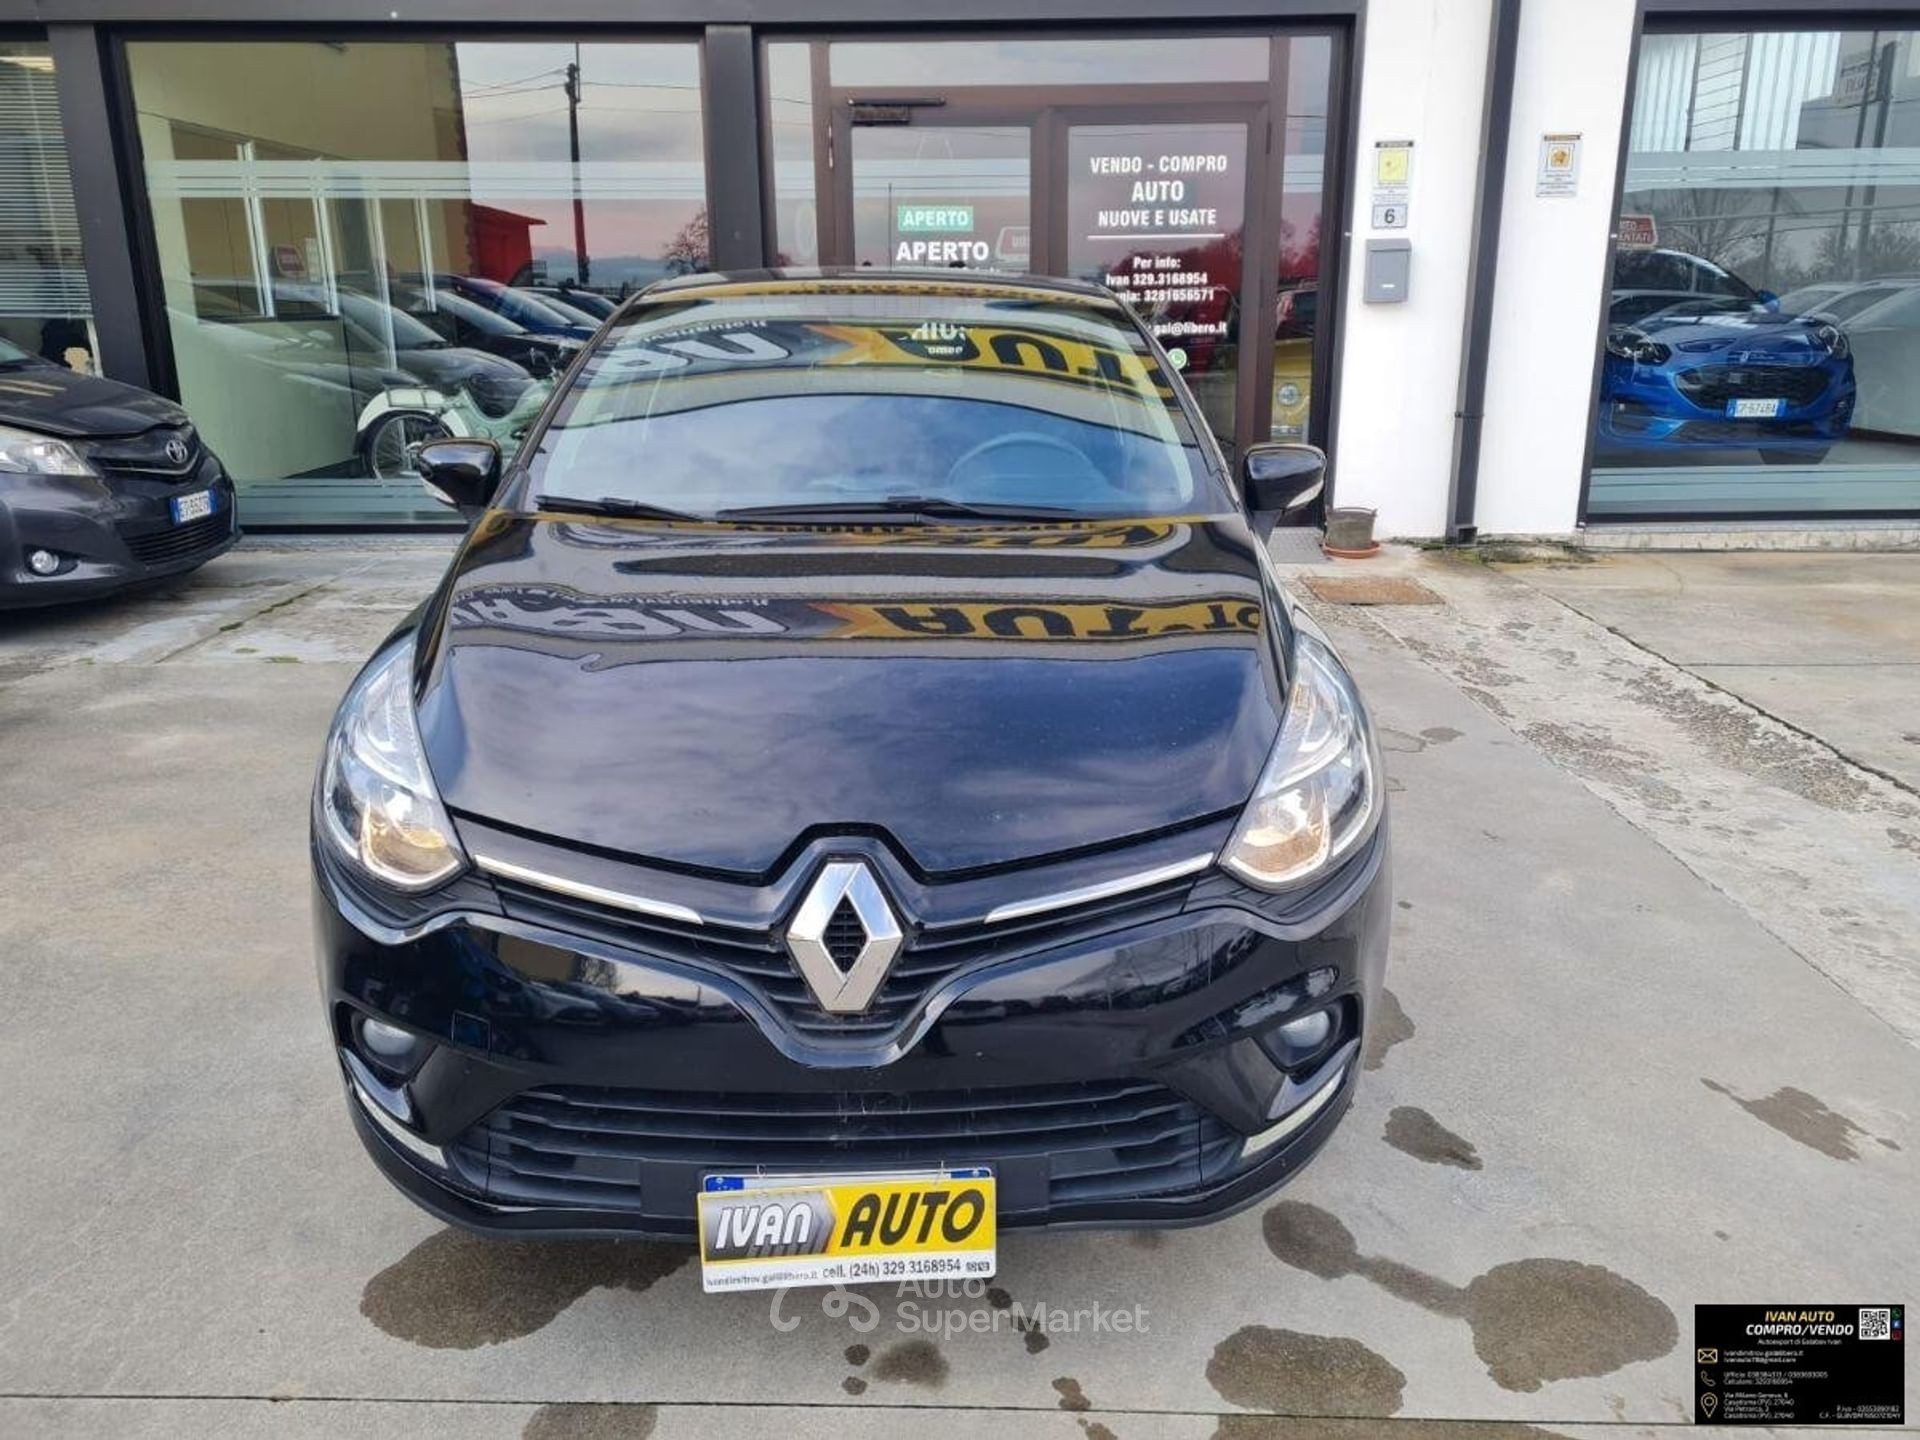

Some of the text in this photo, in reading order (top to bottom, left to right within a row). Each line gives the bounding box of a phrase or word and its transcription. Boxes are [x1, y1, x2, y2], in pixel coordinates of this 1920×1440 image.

[1089, 155, 1143, 174] VENDO
[1158, 154, 1228, 173] COMPRO
[1131, 180, 1185, 202] AUTO
[902, 210, 969, 227] APERTO
[1097, 208, 1217, 228] NUOVE E USATE
[1384, 207, 1395, 224] 6
[895, 241, 990, 262] APERTO
[1132, 256, 1182, 269] Per info:
[1105, 271, 1209, 286] Ivan 329.3168954
[714, 1188, 986, 1250] IVAN AUTO
[821, 1262, 847, 1278] cell.
[849, 1260, 880, 1278] (24h)
